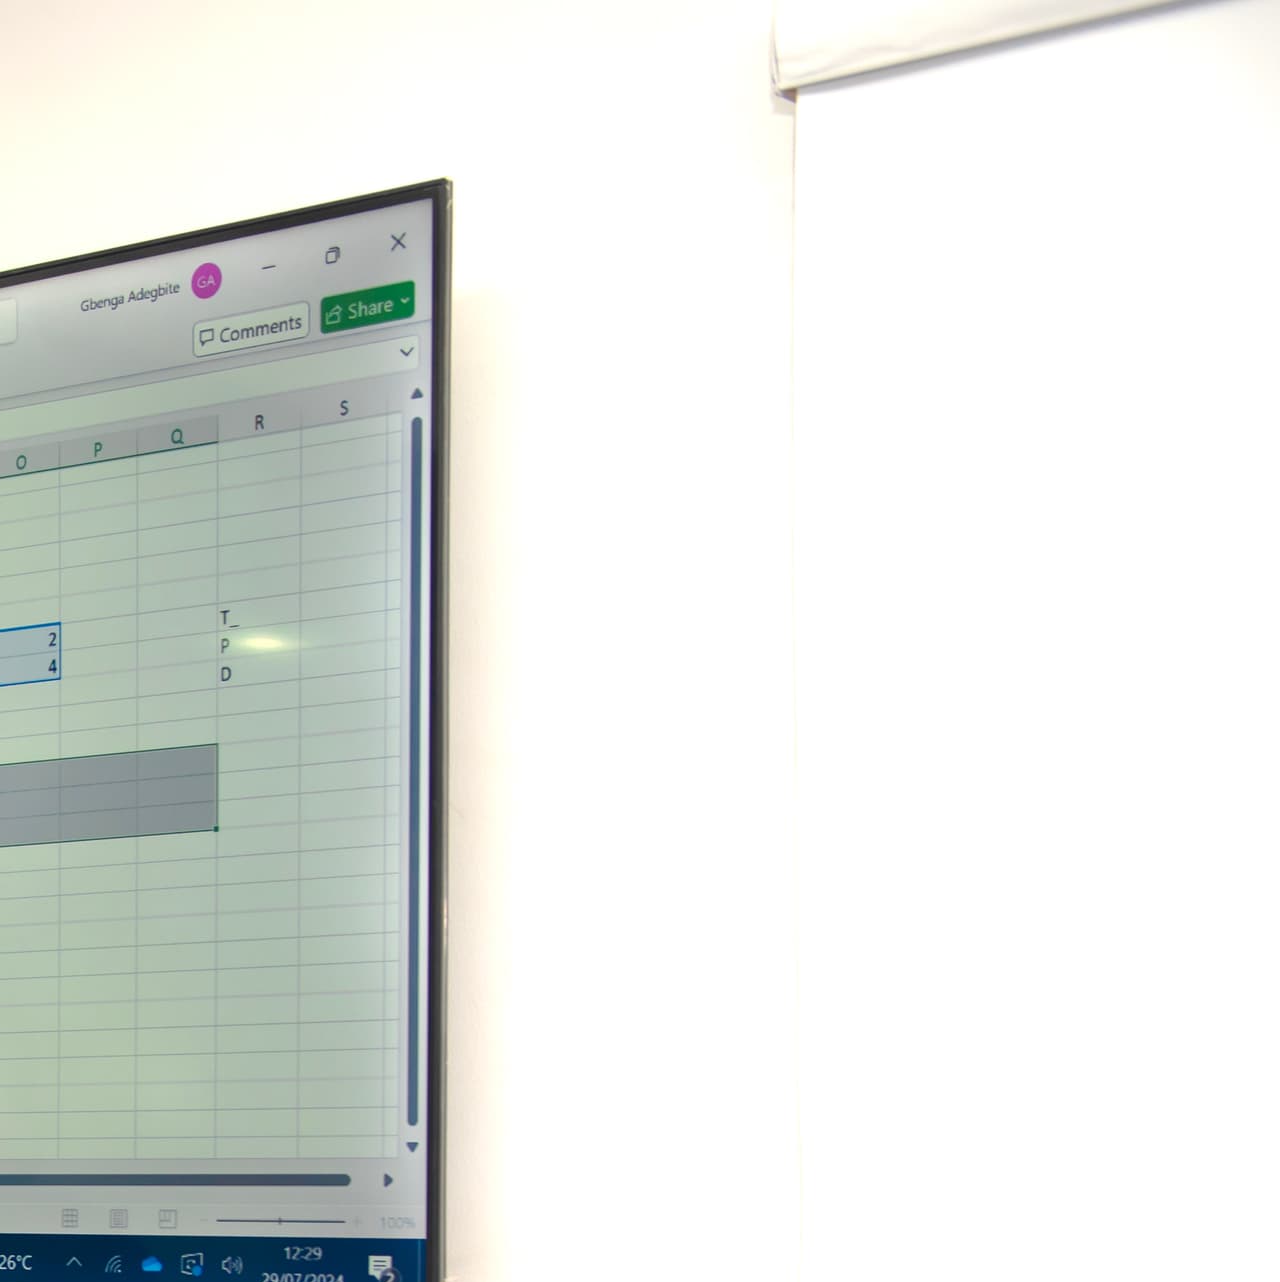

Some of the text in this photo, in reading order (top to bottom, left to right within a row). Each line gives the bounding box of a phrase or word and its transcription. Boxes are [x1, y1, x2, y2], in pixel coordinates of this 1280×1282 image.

[196, 273, 216, 289] GA
[80, 281, 181, 313] Gbenga Adegbite
[347, 298, 394, 320] Share
[219, 315, 302, 344] Comments
[16, 454, 27, 470] O
[94, 442, 103, 457] P
[170, 428, 184, 445] Q
[254, 414, 265, 430] R
[339, 400, 349, 415] S
[220, 609, 239, 628] T_
[48, 632, 57, 648] 2
[221, 638, 230, 654] P
[48, 659, 57, 674] 4
[221, 667, 232, 682] D
[284, 1246, 323, 1261] 12:29
